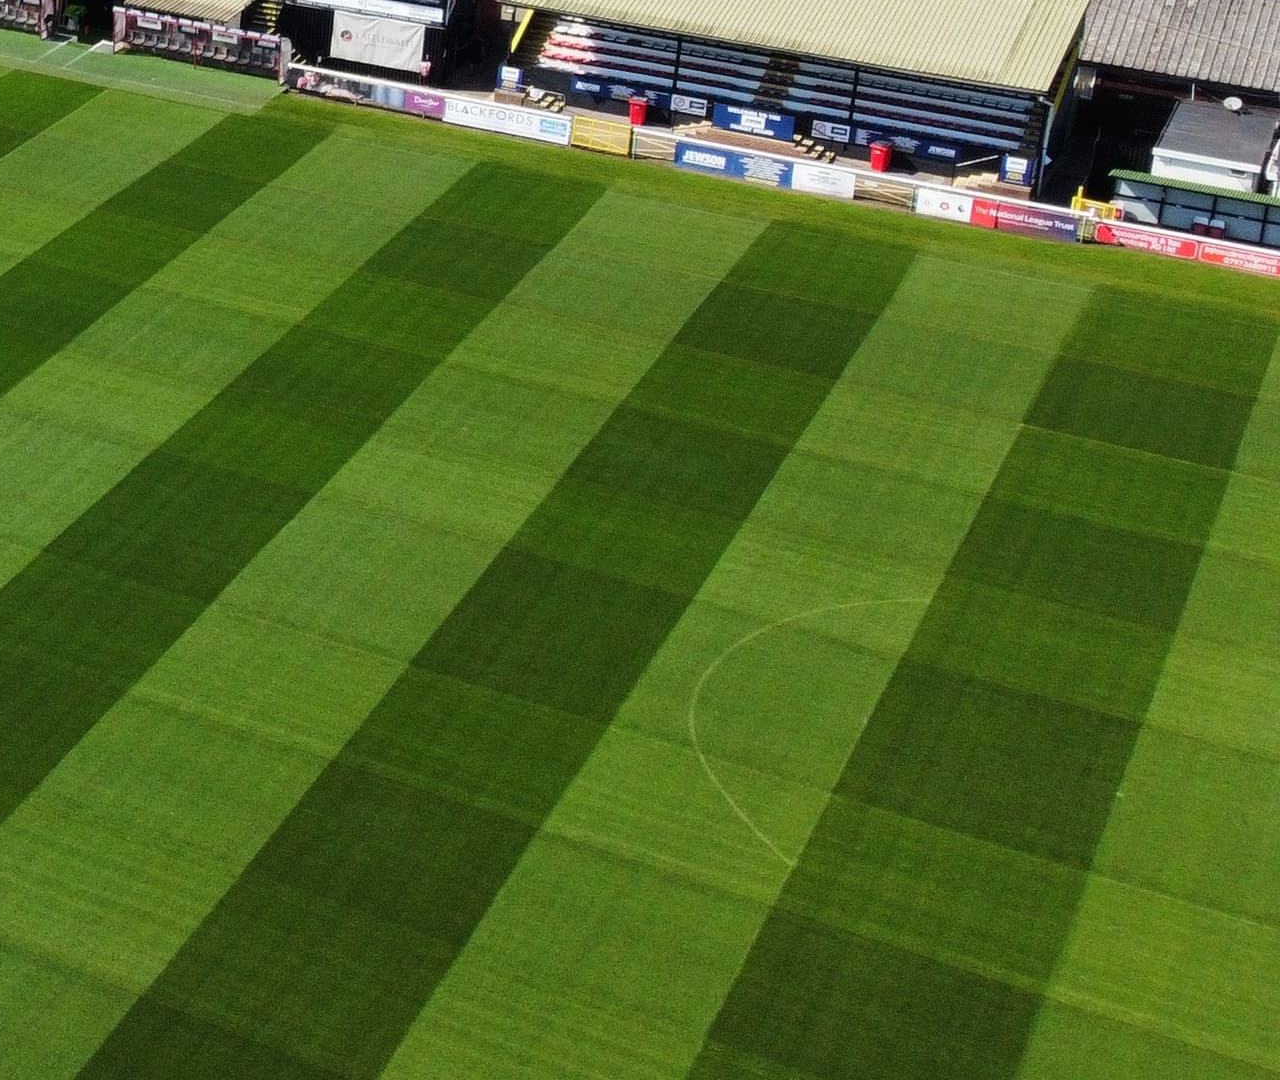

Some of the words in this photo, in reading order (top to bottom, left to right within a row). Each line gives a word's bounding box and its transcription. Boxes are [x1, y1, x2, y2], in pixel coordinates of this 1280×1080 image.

[447, 100, 533, 126] BLACKFORDS
[682, 150, 726, 169] JEWSON
[975, 206, 989, 215] The
[989, 209, 1024, 221] National
[1024, 214, 1053, 227] League
[1054, 220, 1075, 231] Trust
